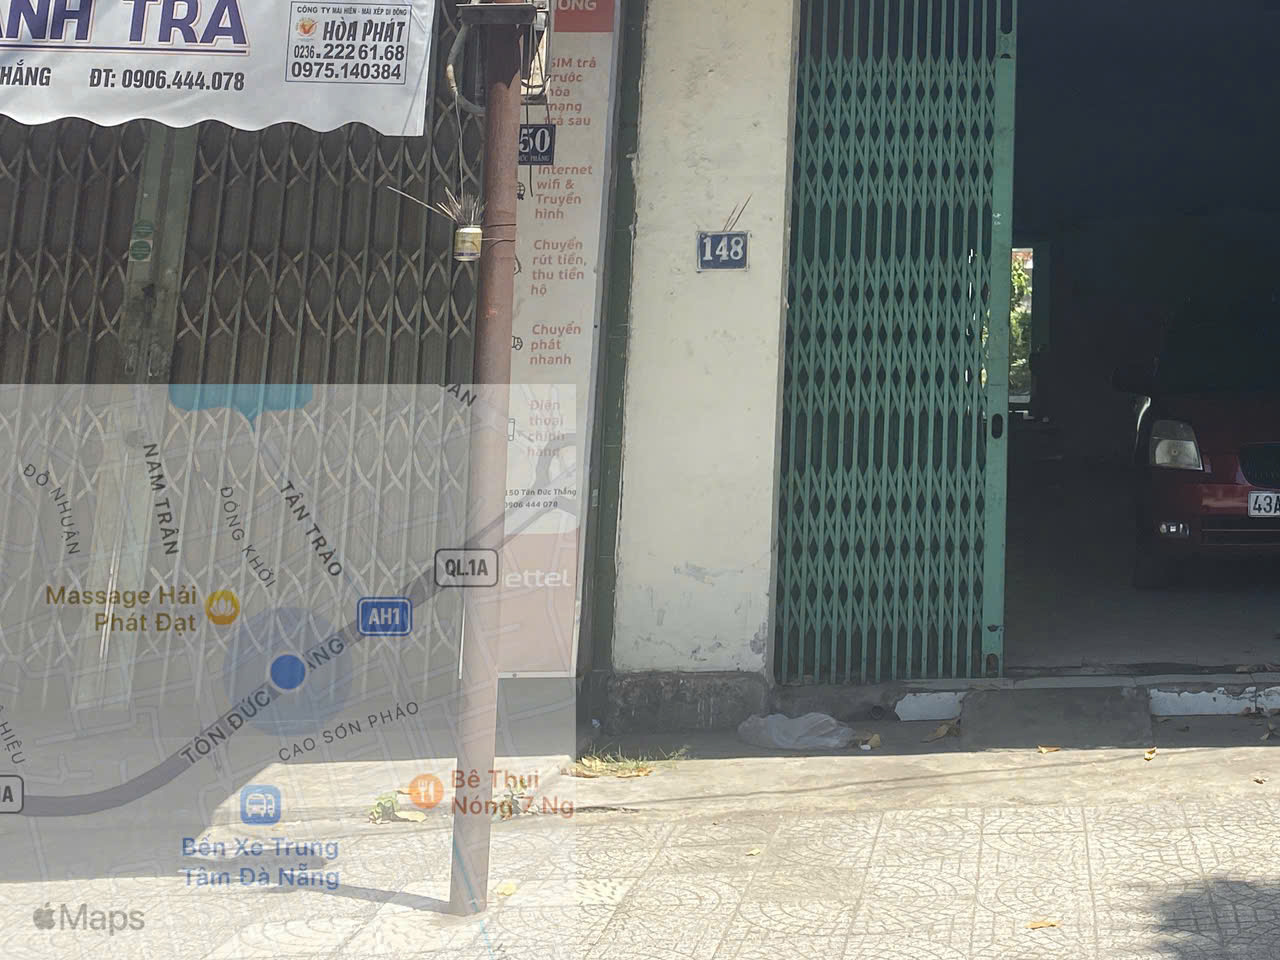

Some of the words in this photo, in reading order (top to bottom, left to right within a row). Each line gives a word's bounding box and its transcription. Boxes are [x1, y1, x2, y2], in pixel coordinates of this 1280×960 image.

[297, 5, 318, 14] CÔNG
[321, 6, 331, 14] TY
[322, 16, 359, 42] HÒA
[361, 17, 406, 43] PHÁT
[291, 61, 402, 80] 0975.140384
[89, 68, 116, 89] ĐT:
[122, 69, 245, 91] 0906.444.078
[550, 73, 583, 83] rước
[568, 116, 591, 126] sau
[519, 128, 550, 153] 50
[538, 165, 593, 175] Internet
[537, 179, 560, 190] wifi
[702, 236, 744, 261] 148
[532, 269, 554, 280] thu
[530, 284, 547, 296] hộ
[531, 338, 561, 353] phát
[530, 354, 572, 365] nhanh
